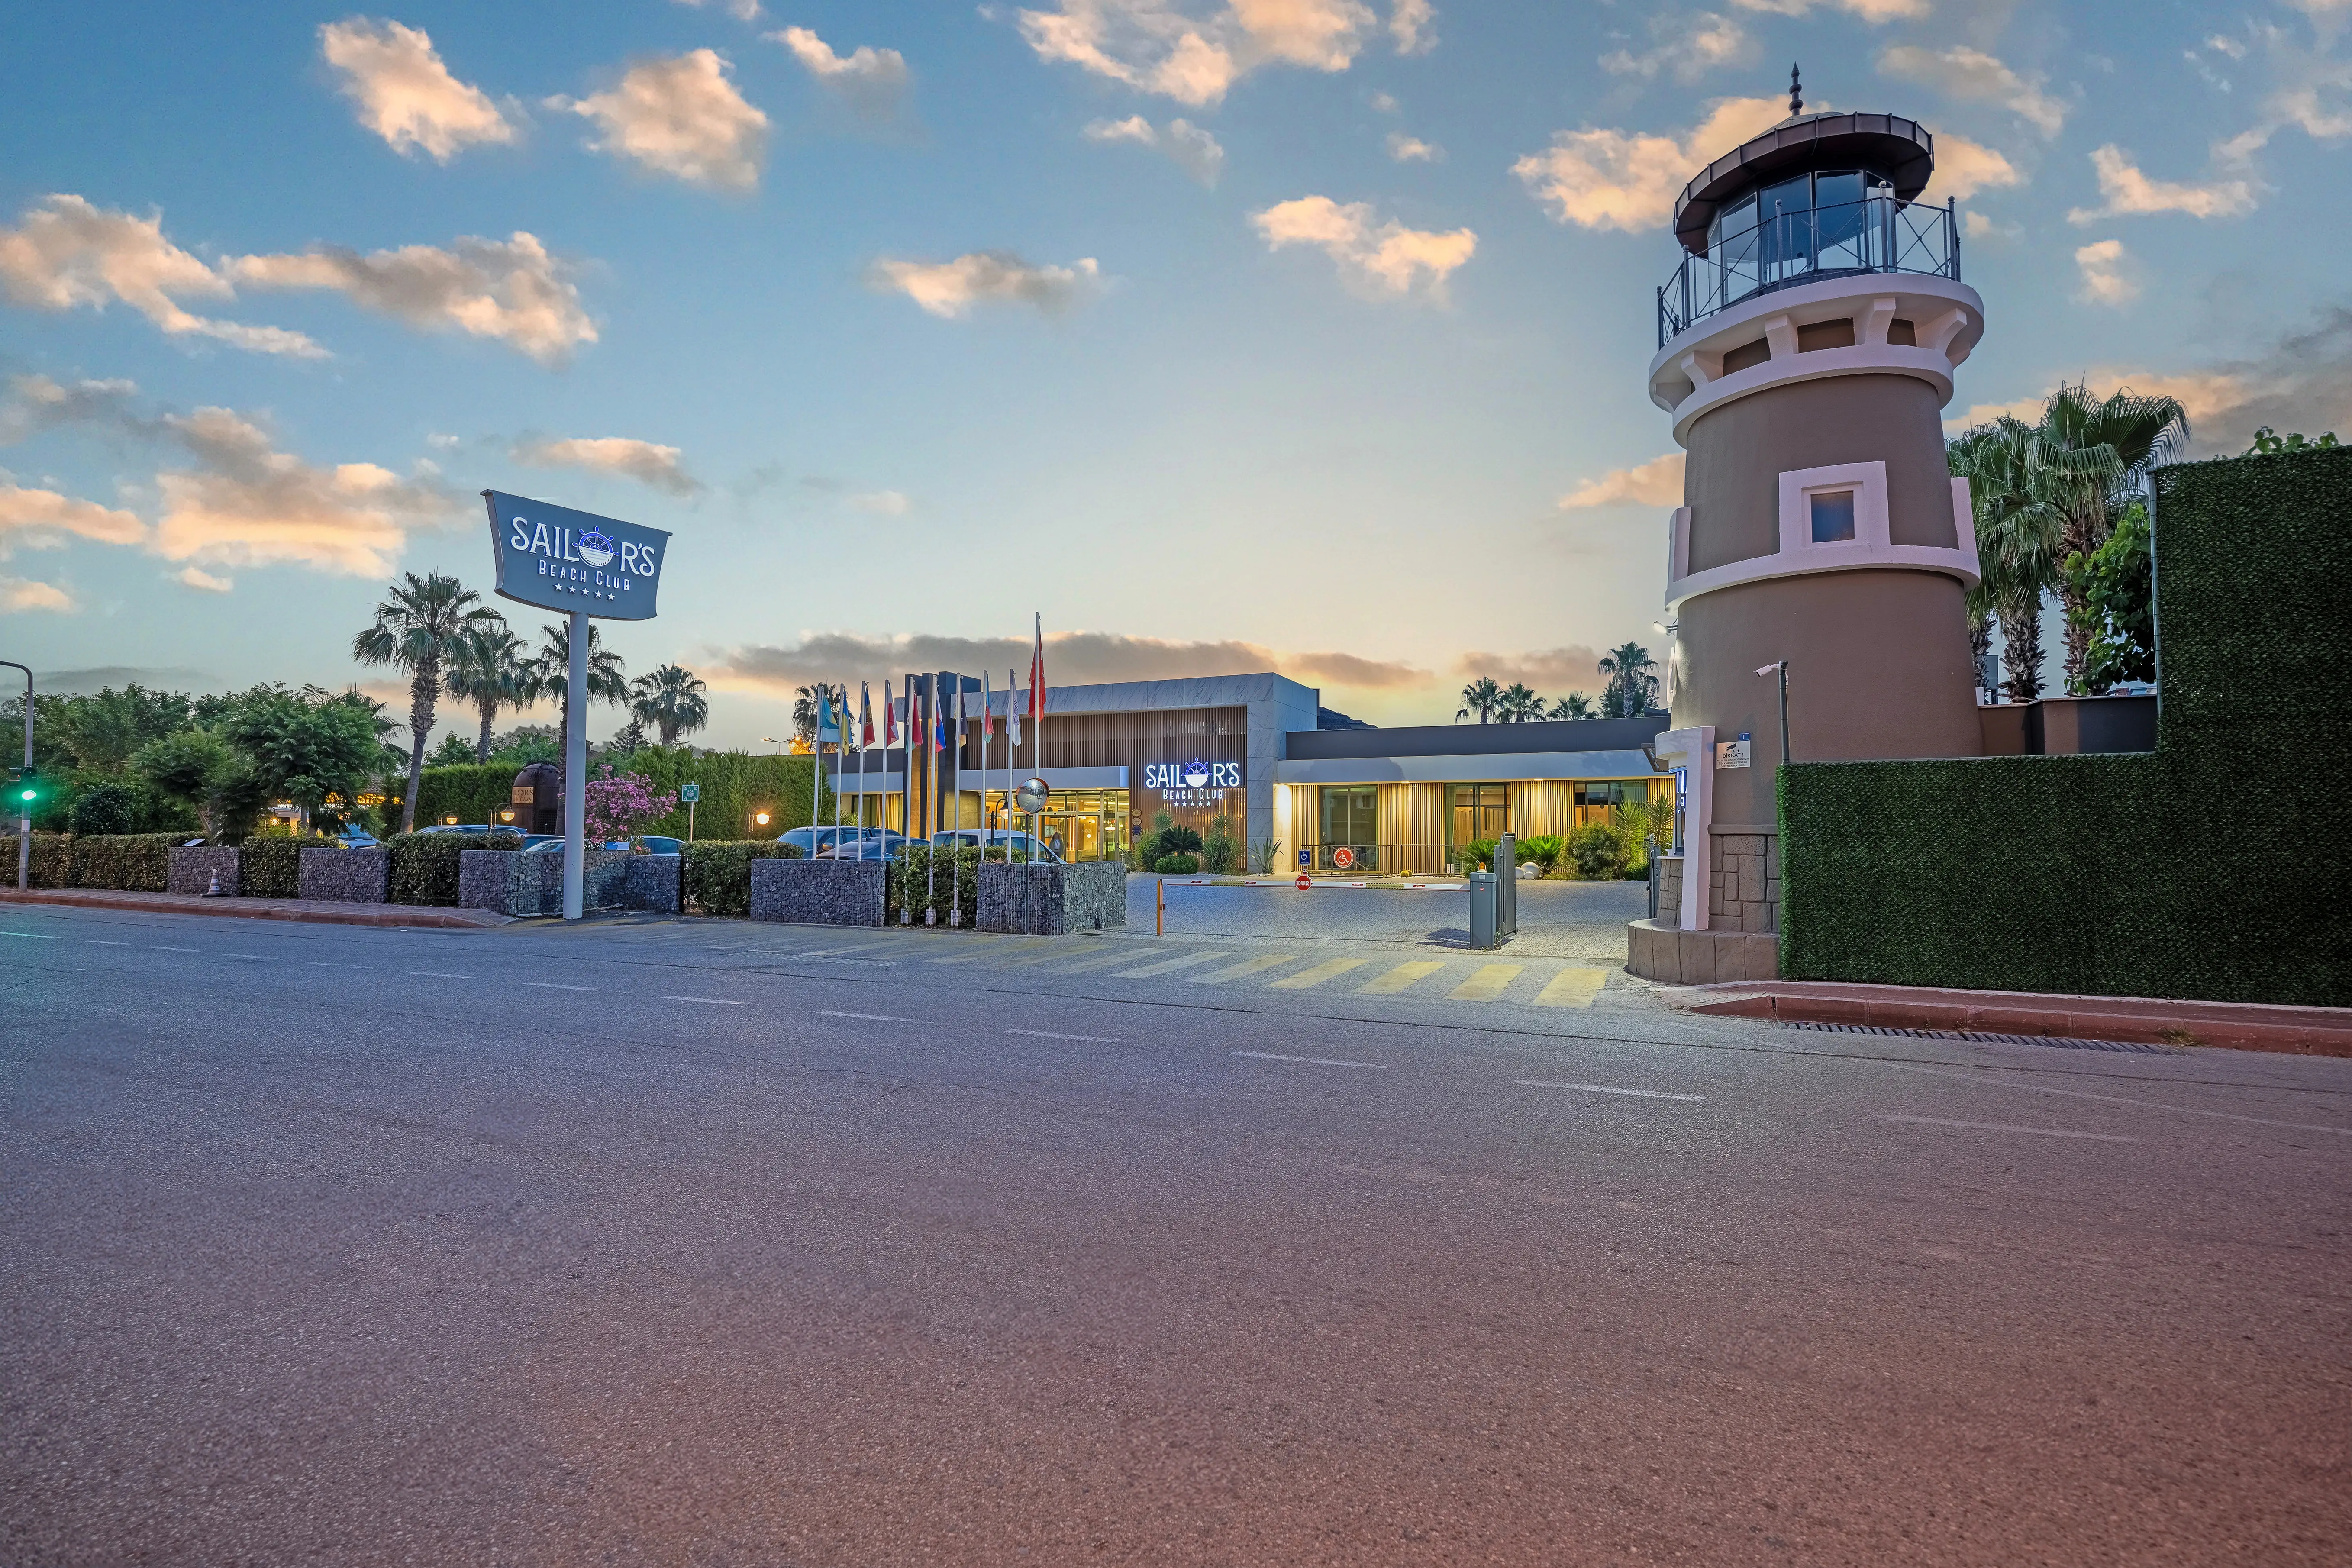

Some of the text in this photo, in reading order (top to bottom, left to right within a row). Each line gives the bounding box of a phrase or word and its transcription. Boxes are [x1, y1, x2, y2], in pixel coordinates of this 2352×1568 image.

[510, 516, 655, 577] SAILOR'S
[538, 559, 630, 591] BEACH CLUB
[1146, 757, 1240, 788] SAILOR'S
[1163, 788, 1223, 800] BEACH CLUB
